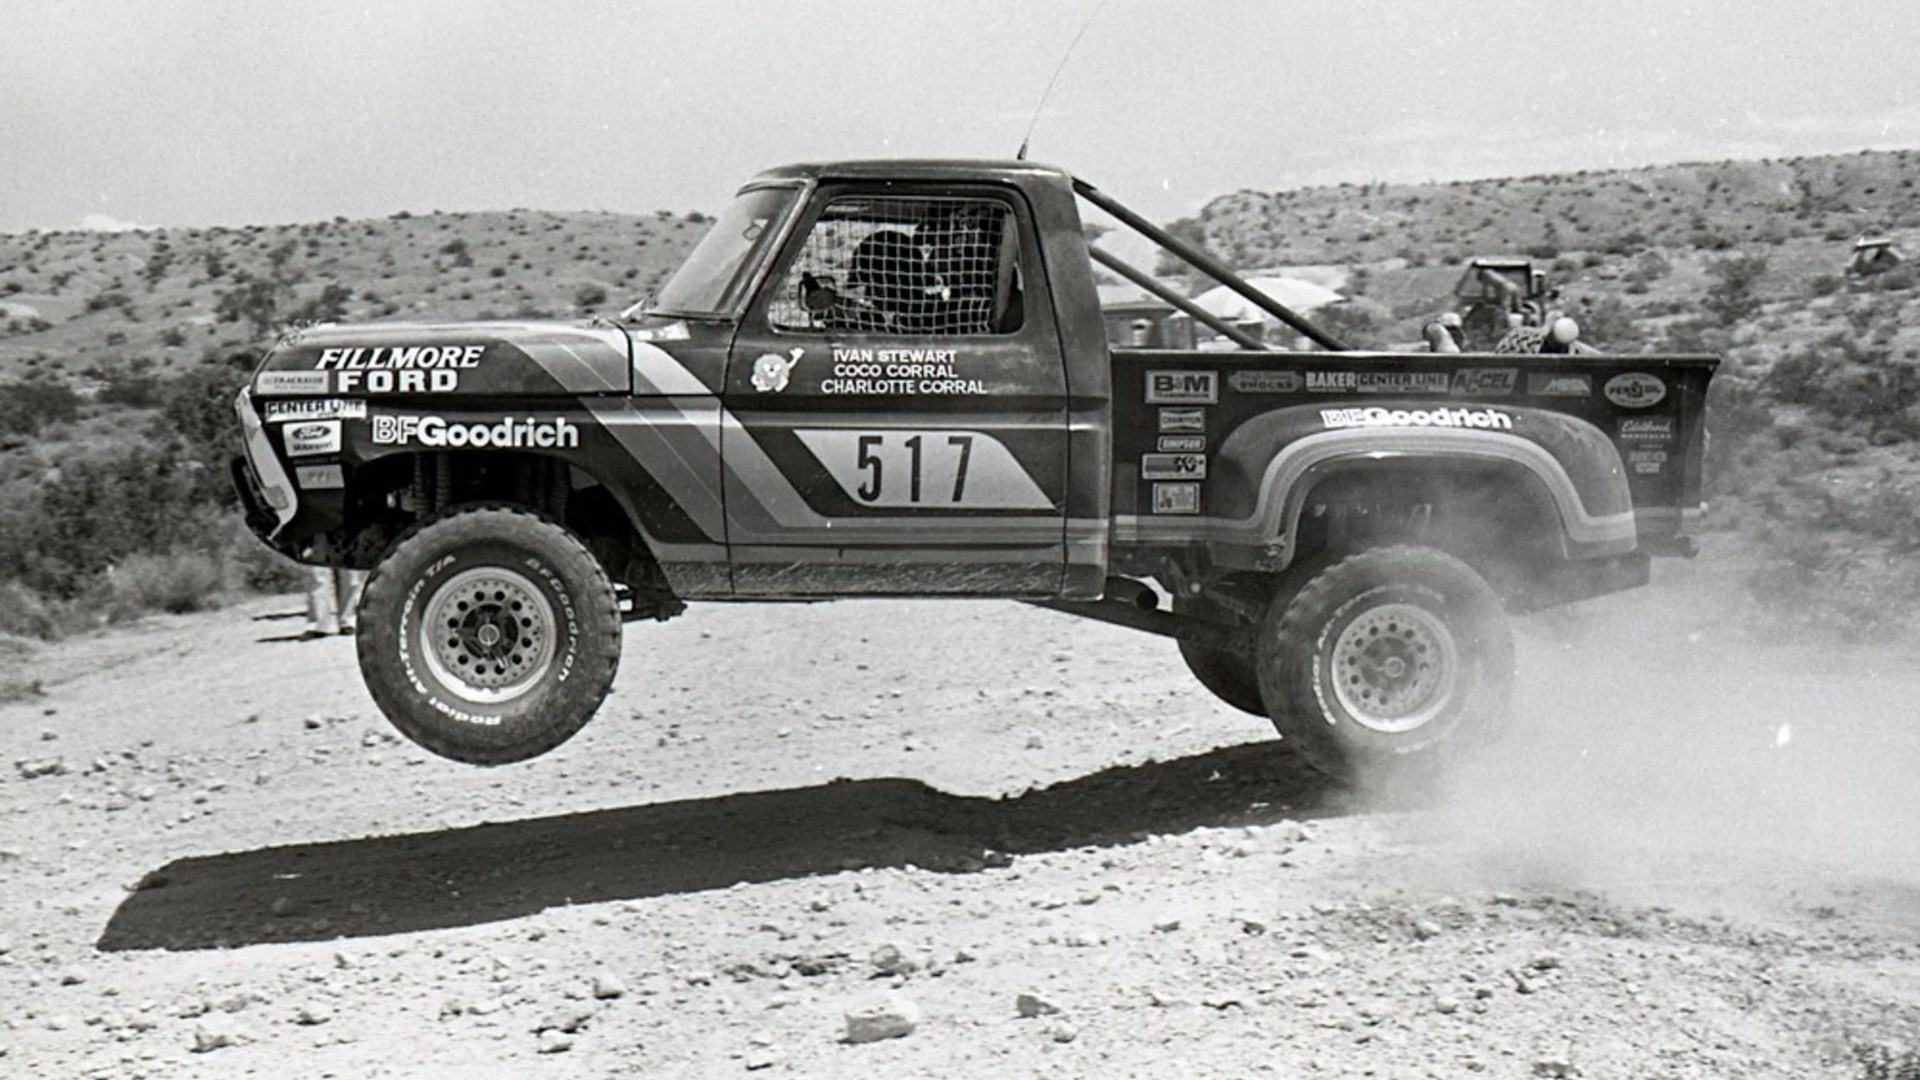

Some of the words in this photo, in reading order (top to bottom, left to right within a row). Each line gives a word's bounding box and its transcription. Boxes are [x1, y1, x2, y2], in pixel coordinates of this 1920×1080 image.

[315, 346, 485, 369] FILLMORE
[833, 350, 875, 363] IVAN
[877, 350, 957, 363] STEWART
[834, 364, 883, 378] COCO
[886, 364, 959, 378] CORRAL
[338, 370, 458, 392] FORD
[821, 379, 915, 394] CHARLOTTE
[919, 379, 987, 394] CORRAL
[1306, 371, 1356, 387] BAKER
[1359, 373, 1412, 385] CENTER
[268, 400, 326, 414] CENTER
[372, 415, 579, 447] BFGoodrich
[857, 435, 973, 502] 517
